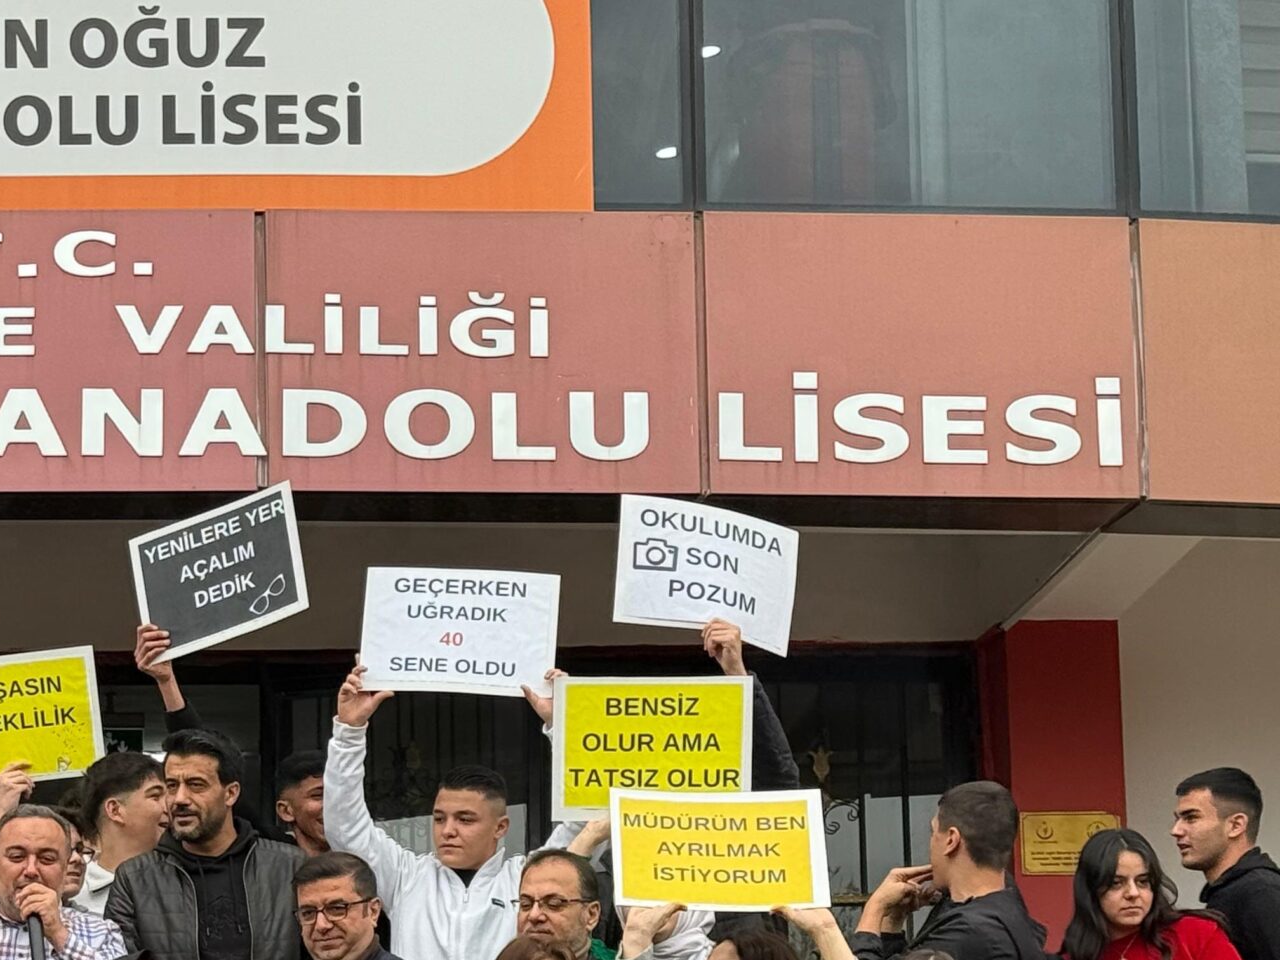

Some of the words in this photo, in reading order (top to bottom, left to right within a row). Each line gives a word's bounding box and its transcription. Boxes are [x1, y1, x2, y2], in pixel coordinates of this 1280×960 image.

[70, 7, 266, 69] OĞUZ
[161, 81, 362, 146] LİSESİ
[116, 291, 548, 357] VALİLİĞİ
[718, 371, 1123, 467] LİSESİ
[144, 515, 242, 564] YENİLERE
[245, 498, 285, 527] YER
[640, 509, 783, 557] OKULUMDA
[180, 541, 255, 583] AÇALIM
[686, 547, 739, 575] SON
[194, 569, 257, 609] DEDİK
[394, 577, 528, 599] GEÇERKEN
[668, 579, 757, 615] POZUM
[407, 601, 508, 622] UĞRADIK
[438, 631, 465, 647] 40
[389, 656, 452, 673] SENE
[455, 659, 517, 677] OLDU
[606, 693, 700, 717] BENSİZ
[582, 733, 655, 752] OLUR
[663, 733, 722, 752] AMA
[569, 768, 659, 788] TATSIZ
[667, 768, 740, 788] OLUR
[623, 811, 748, 831] MÜDÜRÜM
[756, 816, 807, 831] BEN
[657, 842, 781, 858] AYRILMAK
[653, 864, 787, 884] İSTİYORUM
